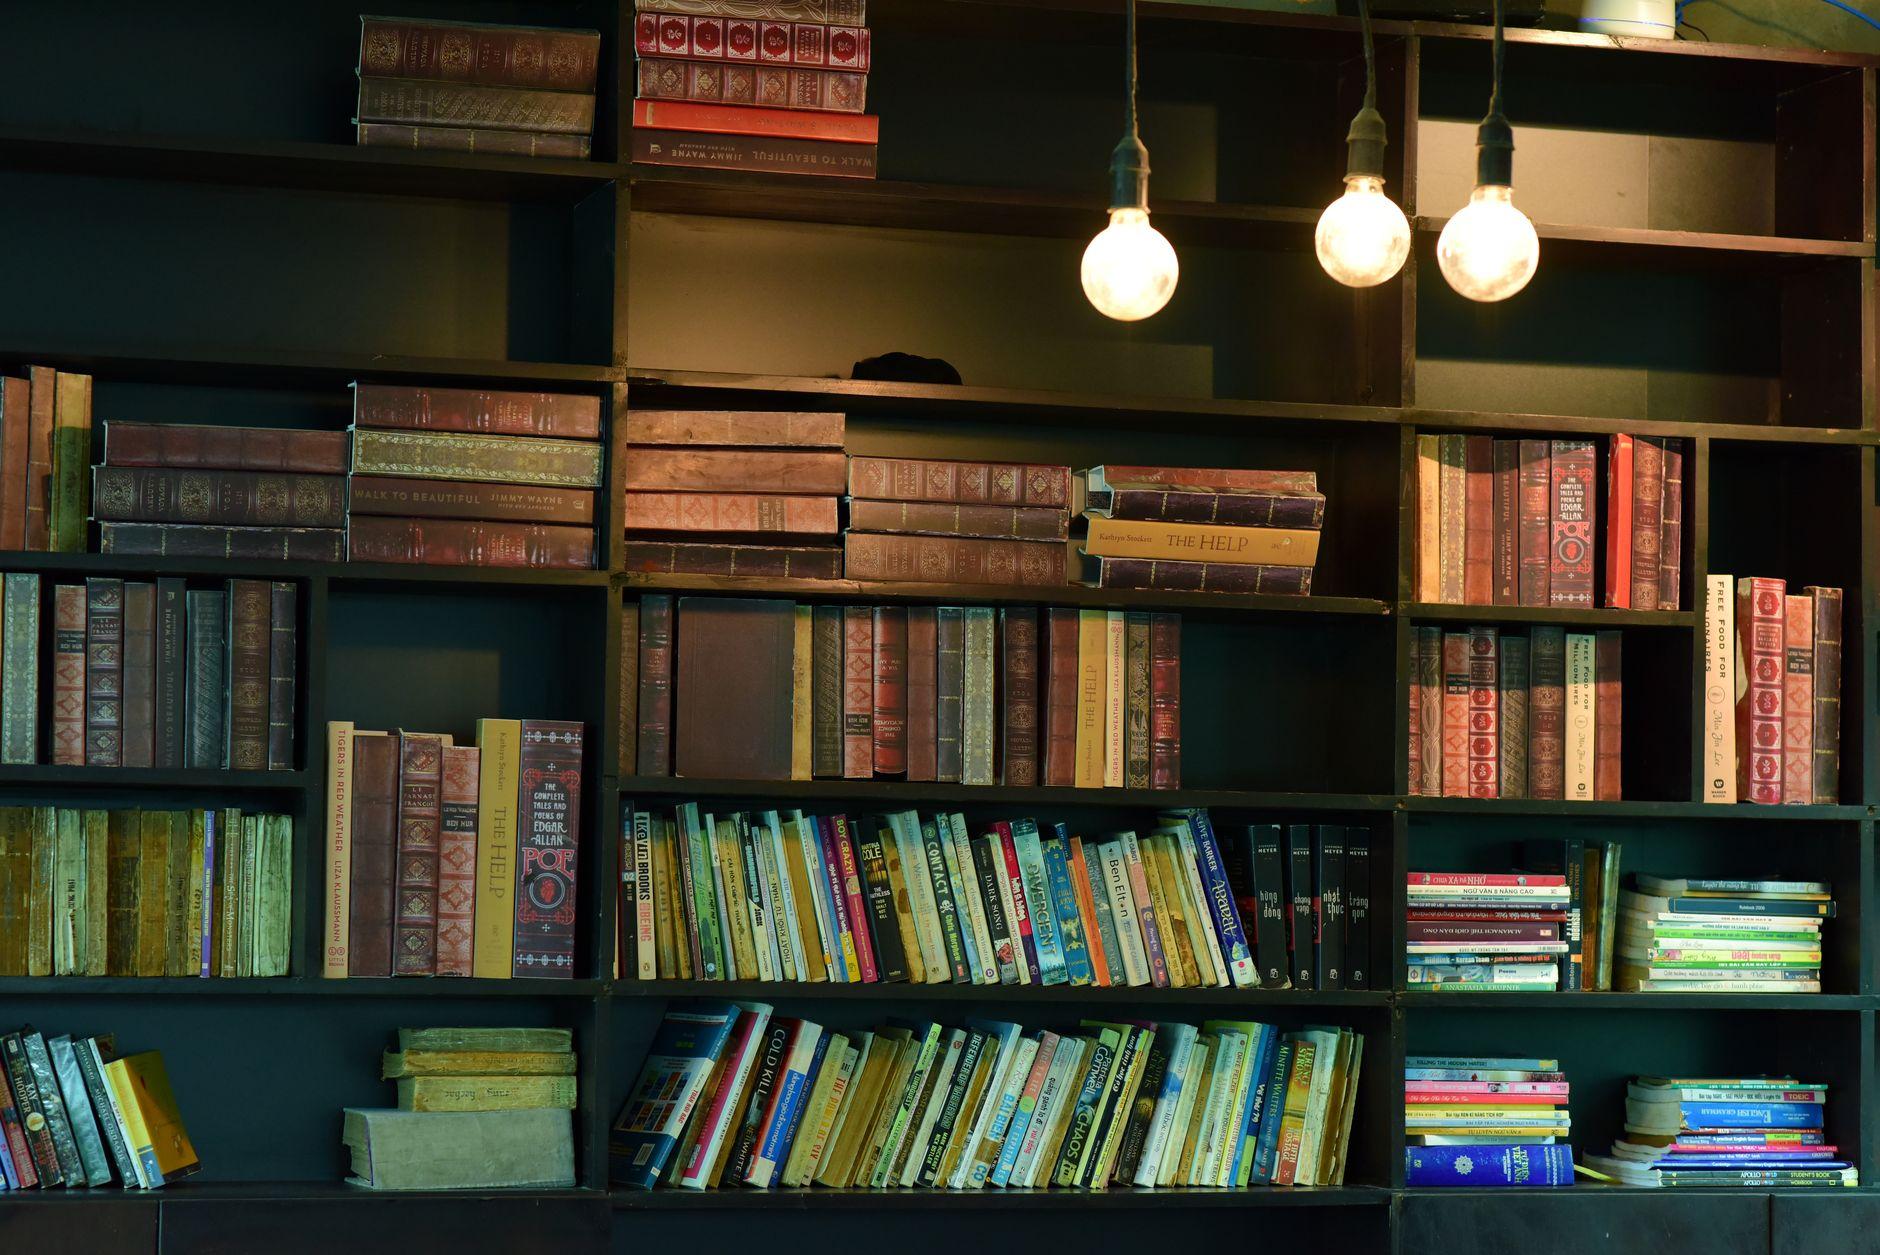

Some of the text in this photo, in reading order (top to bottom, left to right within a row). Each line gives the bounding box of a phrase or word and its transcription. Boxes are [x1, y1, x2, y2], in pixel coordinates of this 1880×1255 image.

[671, 149, 743, 161] JIMMY WAYNE
[752, 150, 873, 168] WALK TO BEAUTIFUL
[354, 489, 481, 505] WALK TO BEAUTIFUL
[490, 493, 563, 506] JIMMY WAYNE
[1503, 474, 1511, 522] BEAUTIFUL
[1559, 489, 1573, 497] TALES
[1558, 512, 1582, 521] ALLAN
[1560, 502, 1585, 512] EDGAR
[1100, 532, 1250, 553] Kathryn THE HELP
[1552, 520, 1591, 544] POE
[164, 608, 172, 664] JIMMY WAYNE
[1716, 581, 1726, 679] FREE FOOD FOR
[166, 670, 175, 722] BEAUTIFUL
[1084, 664, 1097, 729] THE HELP
[1112, 677, 1120, 782] TIGERS RED WEATHER LIZA
[1711, 709, 1723, 768] Min Jin Lee
[497, 731, 508, 761] Kathryn
[533, 792, 565, 801] COMPLETE
[544, 782, 557, 791] THE
[532, 801, 567, 810] TALES AND
[533, 811, 565, 820] POEMS OF
[333, 729, 347, 942] TIGERS IN RED WEATHER LIZA KLAUSSMANN
[446, 819, 473, 828] BEN HUR
[533, 821, 568, 834] EDGAR
[488, 806, 508, 900] THE HELP
[530, 834, 564, 846] ALLAN
[836, 819, 852, 874] BOY CRAZY!
[1128, 843, 1138, 861] CABOT
[1195, 815, 1218, 872] CLIVE BARKER
[521, 846, 576, 882] POE
[861, 847, 882, 861] COLE
[638, 861, 649, 900] BROOKS
[912, 862, 927, 899] WEINER
[1109, 859, 1122, 882] Ben
[927, 840, 962, 961] CONTACT Chris Morphew
[984, 874, 1002, 929] DARK SONG
[1479, 887, 1493, 895] VĂN
[753, 907, 763, 927] JACK
[1025, 862, 1057, 956] DIVERGENT
[1484, 927, 1522, 935] ALMANACH
[1446, 982, 1521, 990] ANASTASIA KRUPNIK
[756, 1027, 787, 1095] COLD KILL
[960, 1034, 981, 1073] DEFENDER
[1029, 1037, 1055, 1093] JANICE LEE
[1234, 1051, 1243, 1068] DAVE
[1294, 1047, 1305, 1082] STRONG
[1301, 1047, 1314, 1086] TERENCE
[956, 1073, 967, 1084] OF
[1084, 1045, 1108, 1095] Cornwell
[1095, 1056, 1111, 1089] Patricia
[1229, 1069, 1239, 1093] PELZER
[1268, 1045, 1289, 1117] MINETTE WALTERS
[14, 1076, 31, 1114] HOOPER
[25, 1083, 38, 1100] KAY
[903, 1072, 921, 1107] TOMBQUEST
[950, 1084, 963, 1099] THE
[816, 1076, 845, 1140] THE OF
[1035, 1117, 1043, 1125] đi
[1224, 1099, 1232, 1116] HELP
[1700, 1109, 1737, 1117] GRAMMAR
[1736, 1109, 1772, 1124] ENGLISH
[1015, 1115, 1026, 1129] THE
[1030, 1129, 1038, 1139] vui
[1066, 1111, 1090, 1159] CHAOS
[1218, 1116, 1229, 1148] YOURSELF
[733, 1125, 755, 1172] NEIL WHITE
[881, 1119, 902, 1164] VALLEY OF KINGS
[925, 1133, 941, 1164] NICK OSTLER
[939, 1131, 948, 1144] MARK
[1024, 1138, 1035, 1155] sống
[1124, 1122, 1139, 1162] MOURNING
[1130, 1128, 1143, 1158] MONDAY
[1281, 1126, 1293, 1160] HOSTAGE
[1288, 1128, 1299, 1163] THE FIFTH
[1211, 1163, 1219, 1182] TEENS
[1513, 1165, 1523, 1183] ANH
